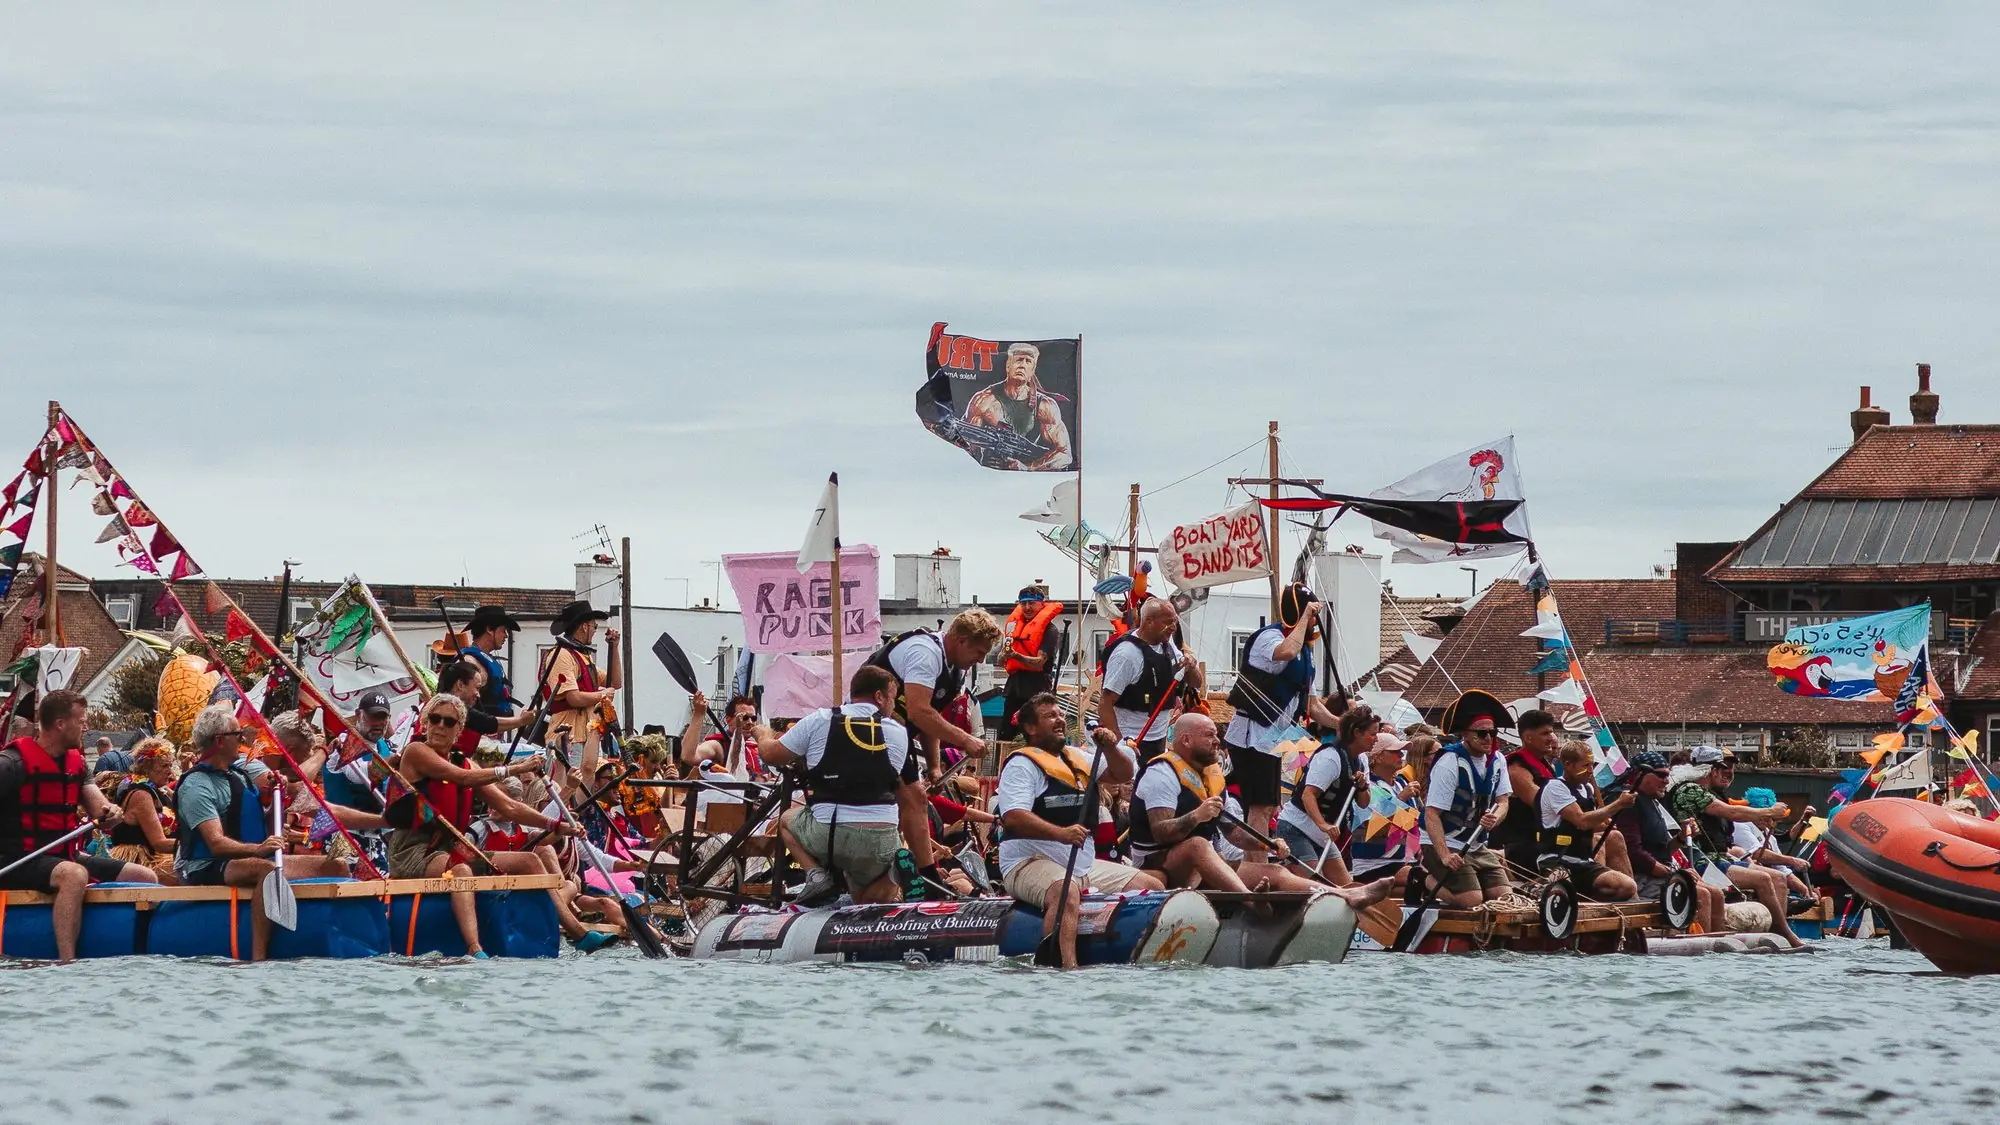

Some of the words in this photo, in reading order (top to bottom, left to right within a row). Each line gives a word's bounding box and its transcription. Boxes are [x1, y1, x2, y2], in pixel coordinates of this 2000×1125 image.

[815, 507, 826, 526] 7
[1182, 539, 1263, 579] BANDITS
[758, 608, 864, 646] PUNK
[831, 923, 874, 935] Sussex
[874, 919, 929, 933] Roofing
[931, 918, 942, 930] &
[944, 915, 1001, 930] Building
[894, 933, 918, 941] Services
